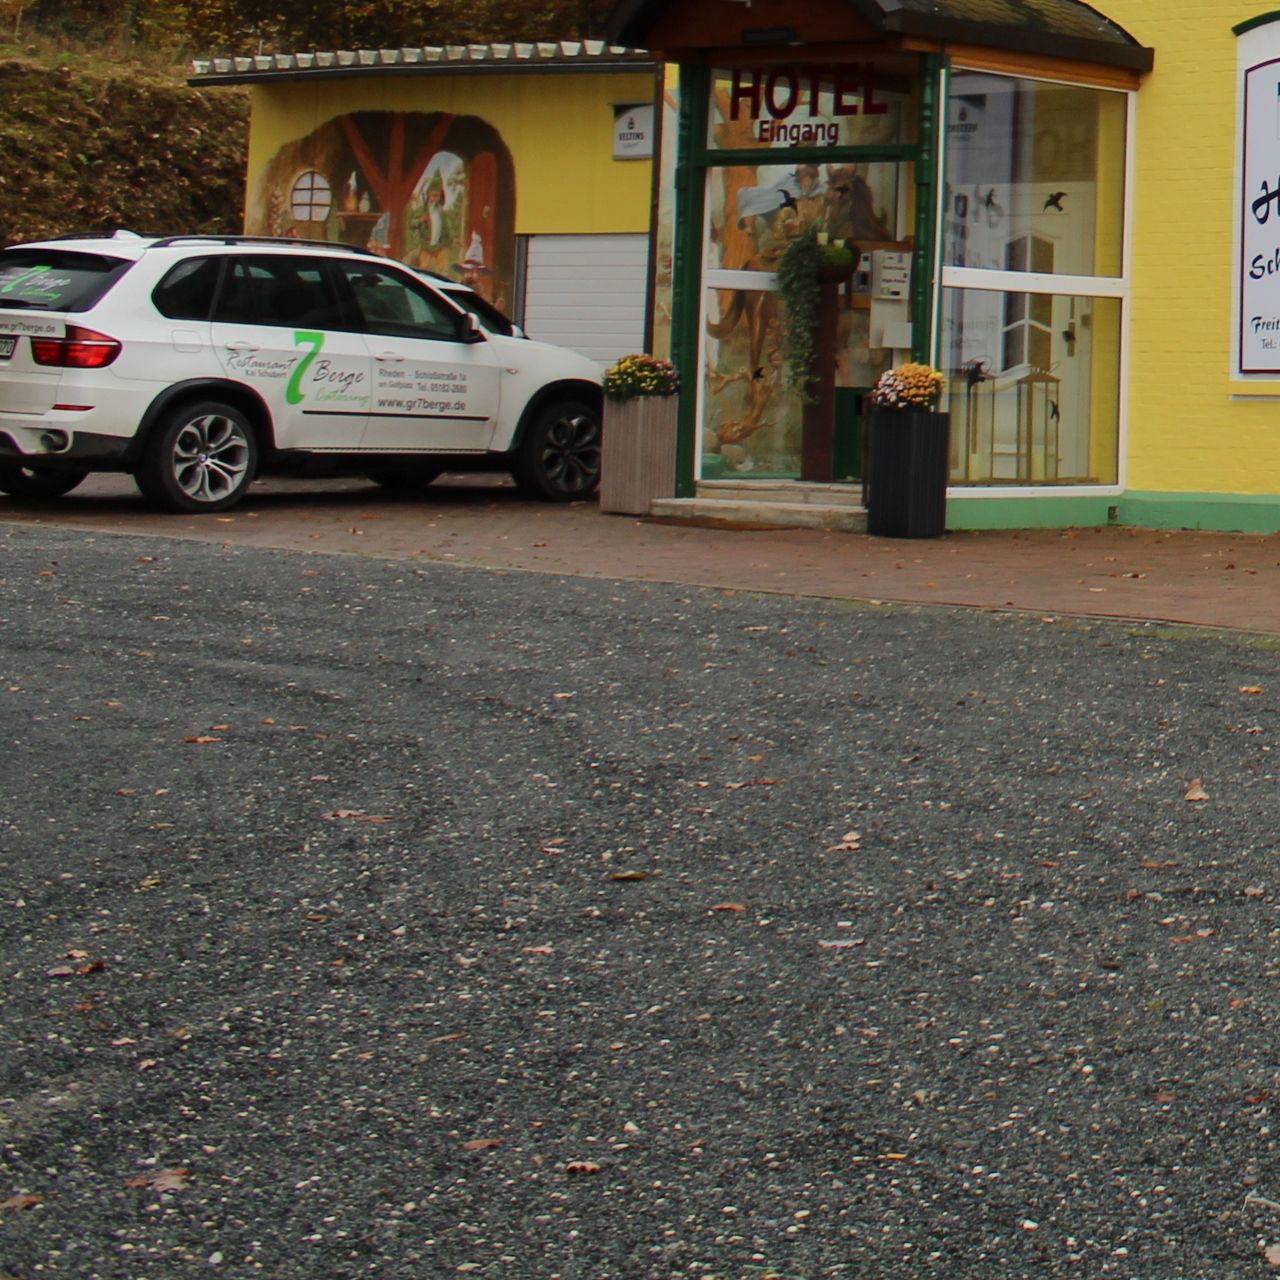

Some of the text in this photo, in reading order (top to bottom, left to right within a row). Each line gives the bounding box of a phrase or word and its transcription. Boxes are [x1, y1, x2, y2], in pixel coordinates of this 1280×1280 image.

[730, 61, 888, 121] HOTEL
[618, 132, 644, 141] VELTINS
[758, 120, 839, 147] Eingang
[226, 351, 298, 370] Restaurant
[285, 331, 325, 406] 7
[312, 360, 365, 394] Berge
[378, 398, 467, 412] www.gr7berge.de
